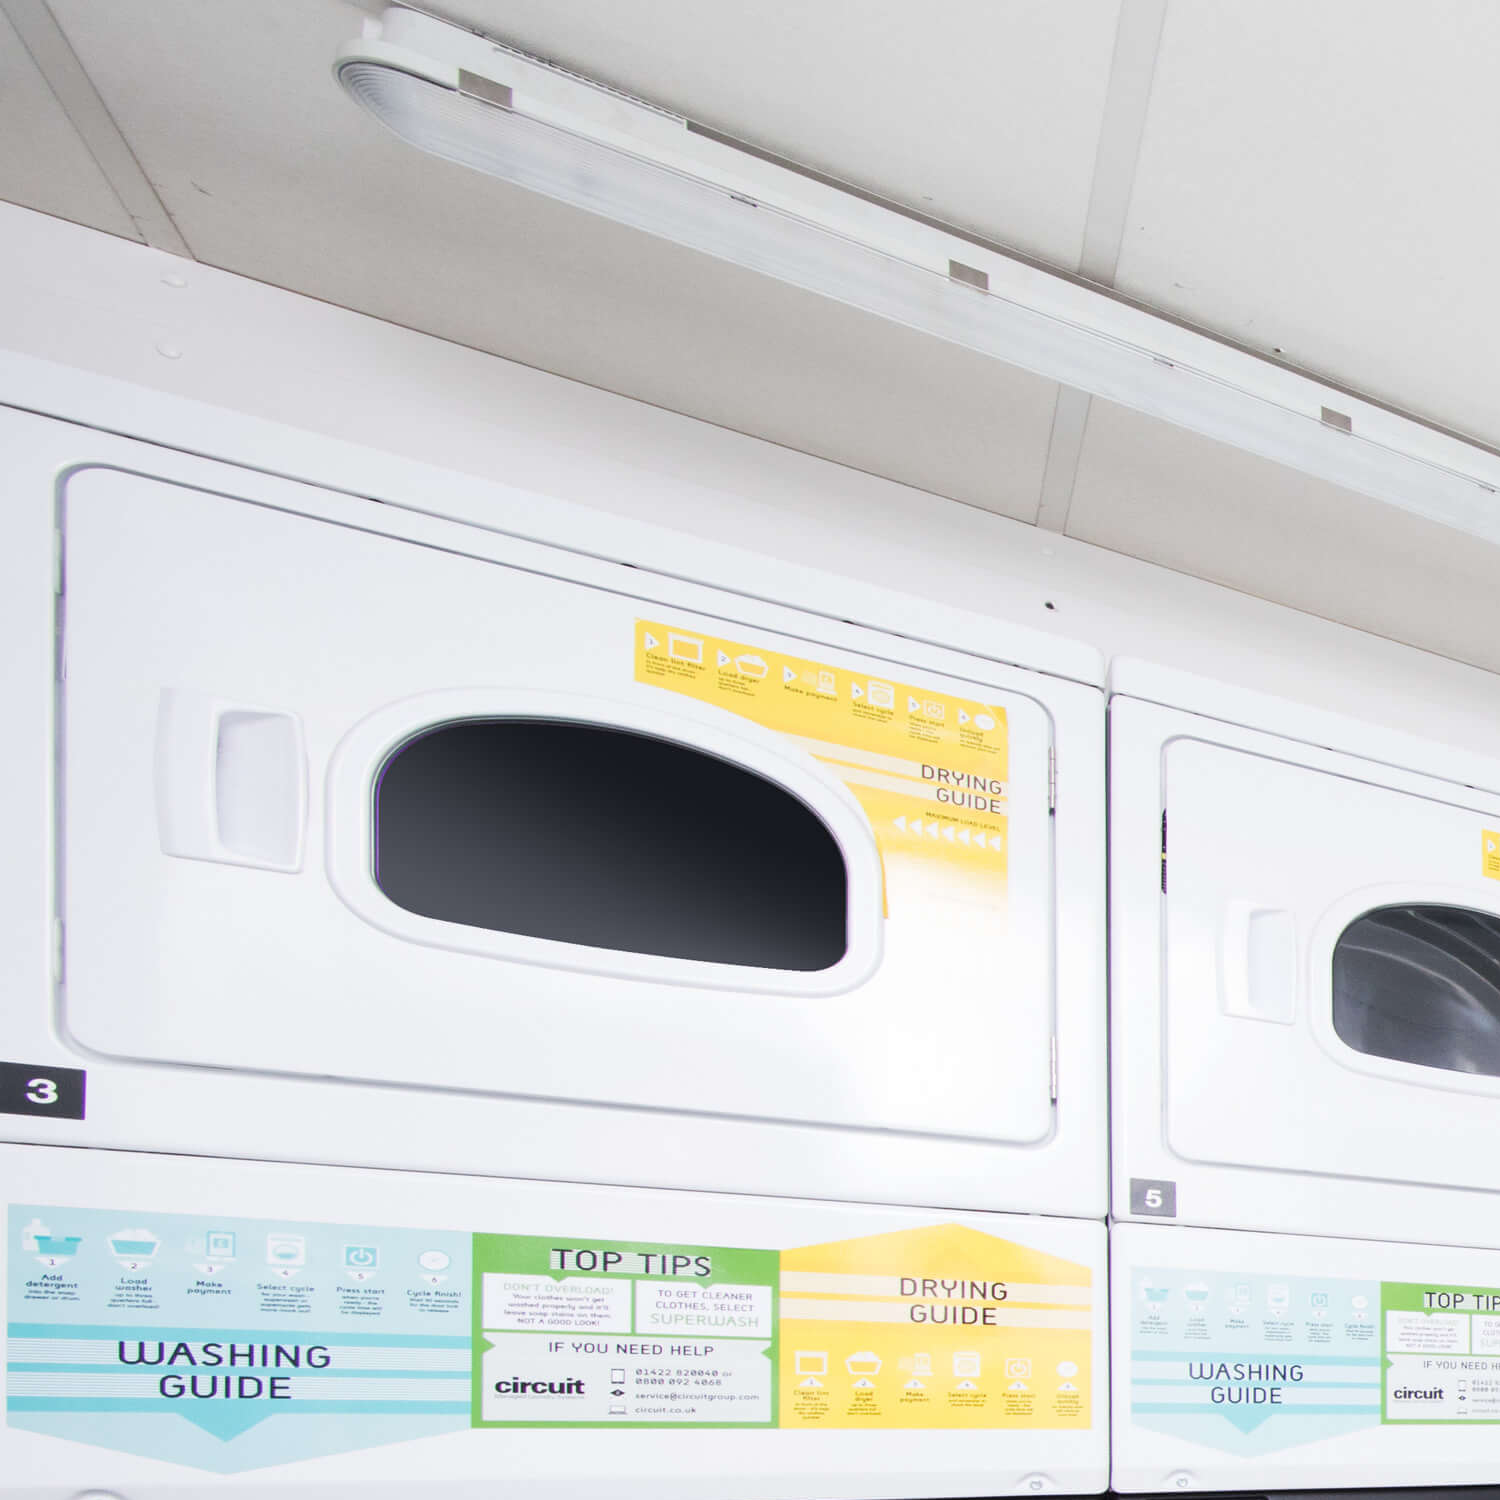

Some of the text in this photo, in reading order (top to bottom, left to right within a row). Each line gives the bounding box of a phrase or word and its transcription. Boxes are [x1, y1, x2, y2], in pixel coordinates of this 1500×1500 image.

[921, 764, 1002, 794] DRYING
[936, 788, 1002, 814] GUIDE
[26, 1078, 58, 1104] 3
[1145, 1189, 1162, 1207] 5
[552, 1249, 710, 1277] TOP TIPS
[25, 1281, 78, 1289] detergent
[187, 1287, 232, 1295] payment
[900, 1278, 1008, 1300] DRYING
[407, 1290, 431, 1298] Cycle
[658, 1290, 752, 1300] TO GET CLEANER
[1425, 1292, 1464, 1309] TOP
[714, 1303, 754, 1312] SELECT
[910, 1304, 997, 1326] GUIDE
[650, 1313, 760, 1328] SUPERWASH
[118, 1341, 331, 1368] WASHING
[549, 1342, 714, 1356] IF YOU NEED HELP
[1189, 1362, 1304, 1381] WASHING
[159, 1374, 292, 1400] GUIDE
[495, 1377, 585, 1394] circuit
[1394, 1387, 1443, 1399] circuit
[1211, 1387, 1282, 1404] GUIDE
